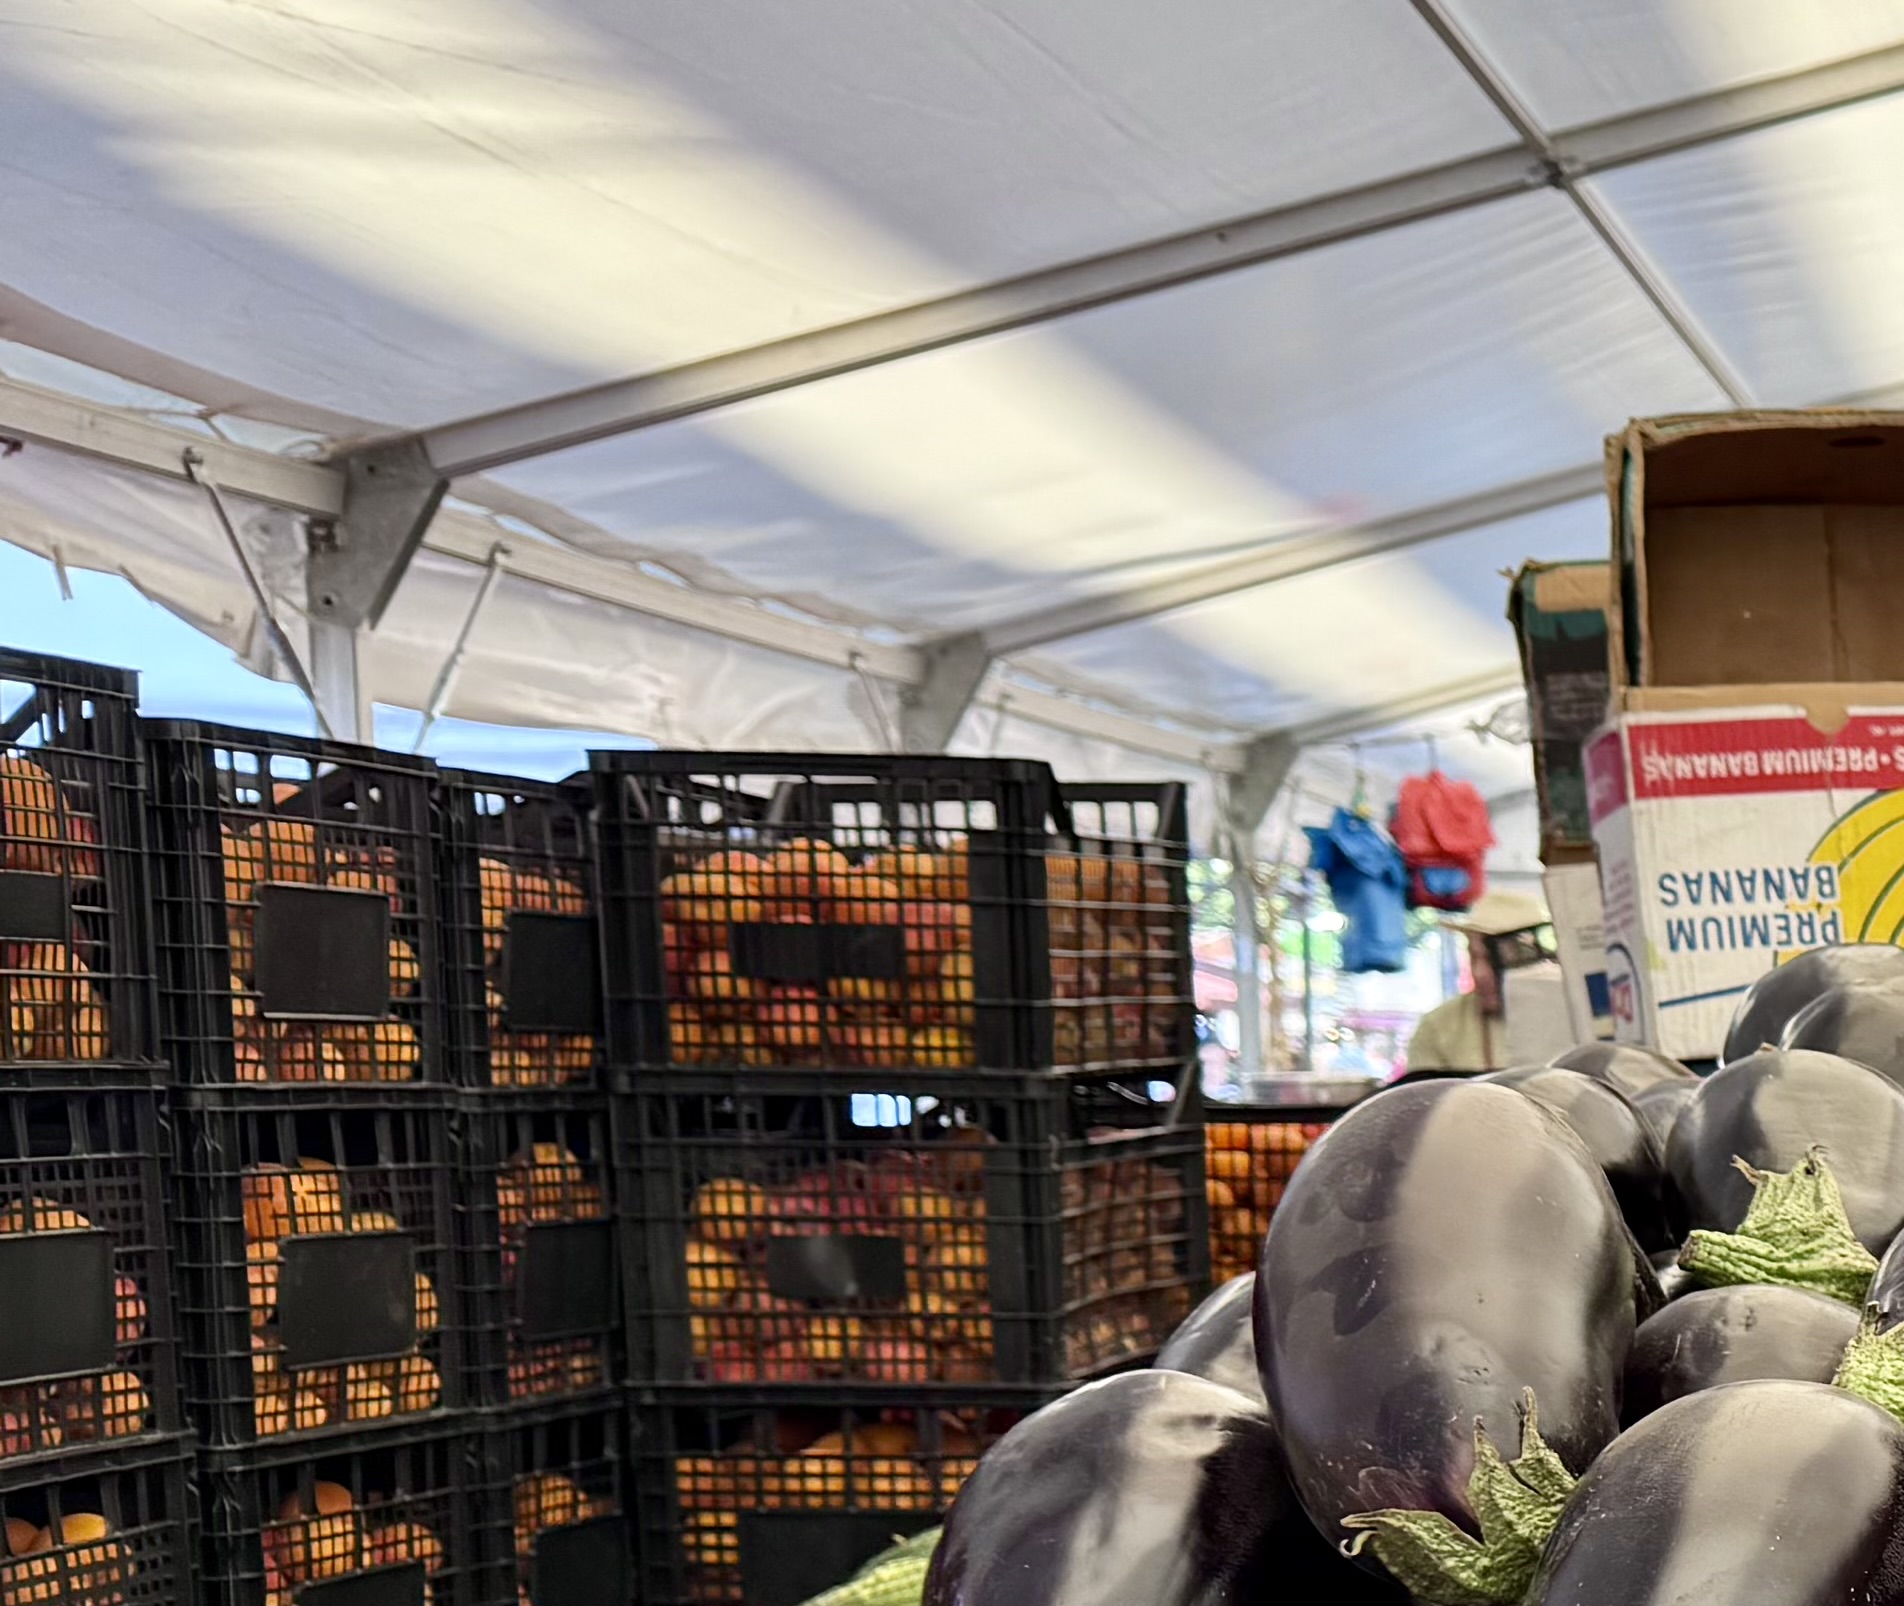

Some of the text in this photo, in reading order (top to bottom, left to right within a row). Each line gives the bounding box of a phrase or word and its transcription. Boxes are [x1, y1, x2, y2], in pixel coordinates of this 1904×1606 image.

[1641, 749, 1758, 783] BANANAS
[1762, 746, 1878, 776] PREMIUM
[1658, 864, 1837, 906] BANANAS
[1666, 909, 1842, 951] PREMIUM
